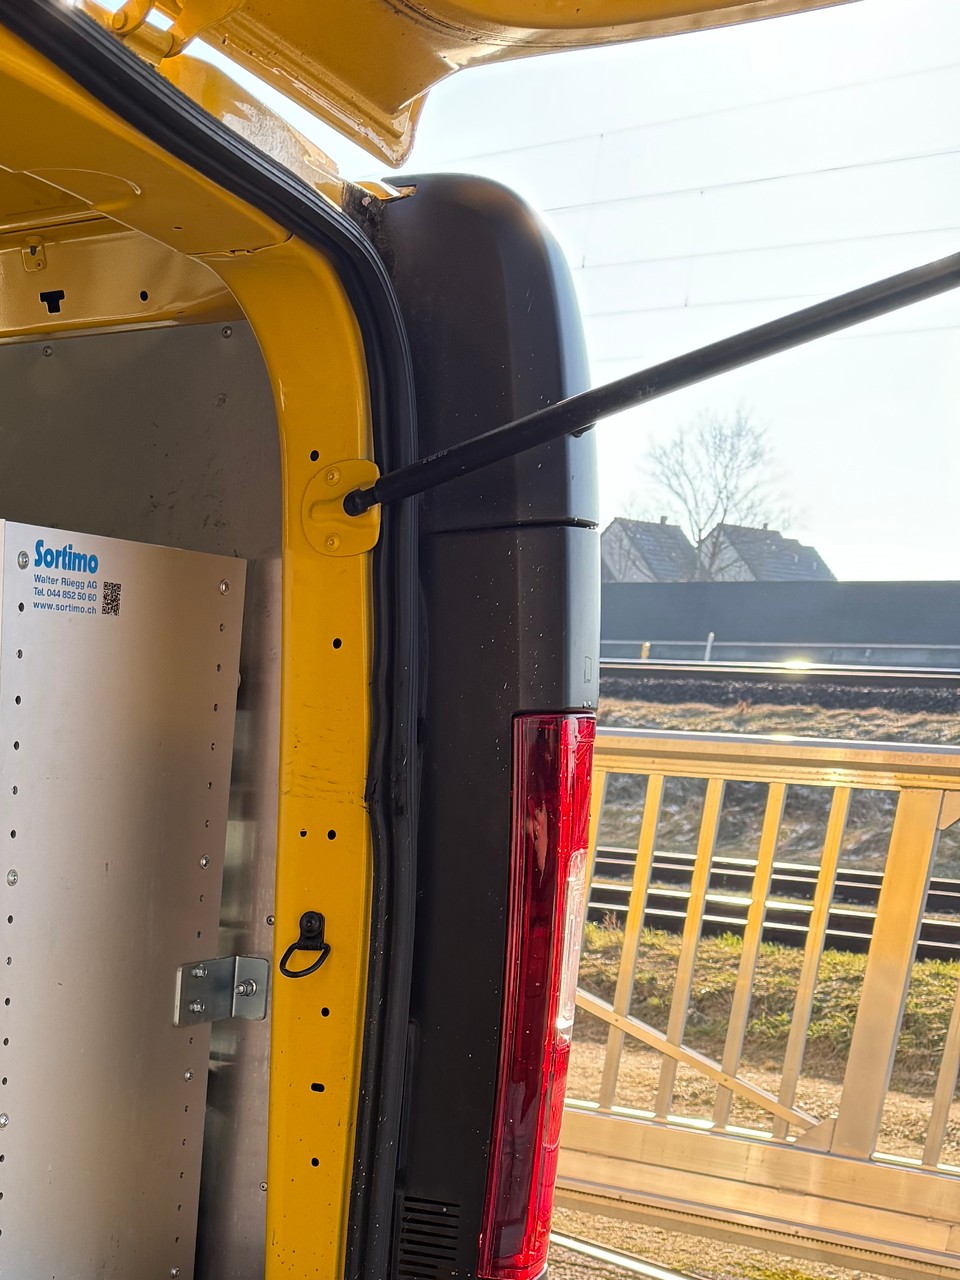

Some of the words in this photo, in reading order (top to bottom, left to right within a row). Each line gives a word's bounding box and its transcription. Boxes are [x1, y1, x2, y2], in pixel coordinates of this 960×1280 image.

[34, 539, 99, 574] Sortimo
[33, 574, 59, 586] Walter
[61, 577, 85, 590] Rüegg
[86, 581, 98, 590] AG
[33, 586, 46, 597] Tel.
[46, 588, 61, 598] 044
[62, 590, 76, 600] 852
[77, 592, 87, 601] 50
[87, 592, 97, 602] 60
[33, 602, 97, 614] www.sortimo.ch
